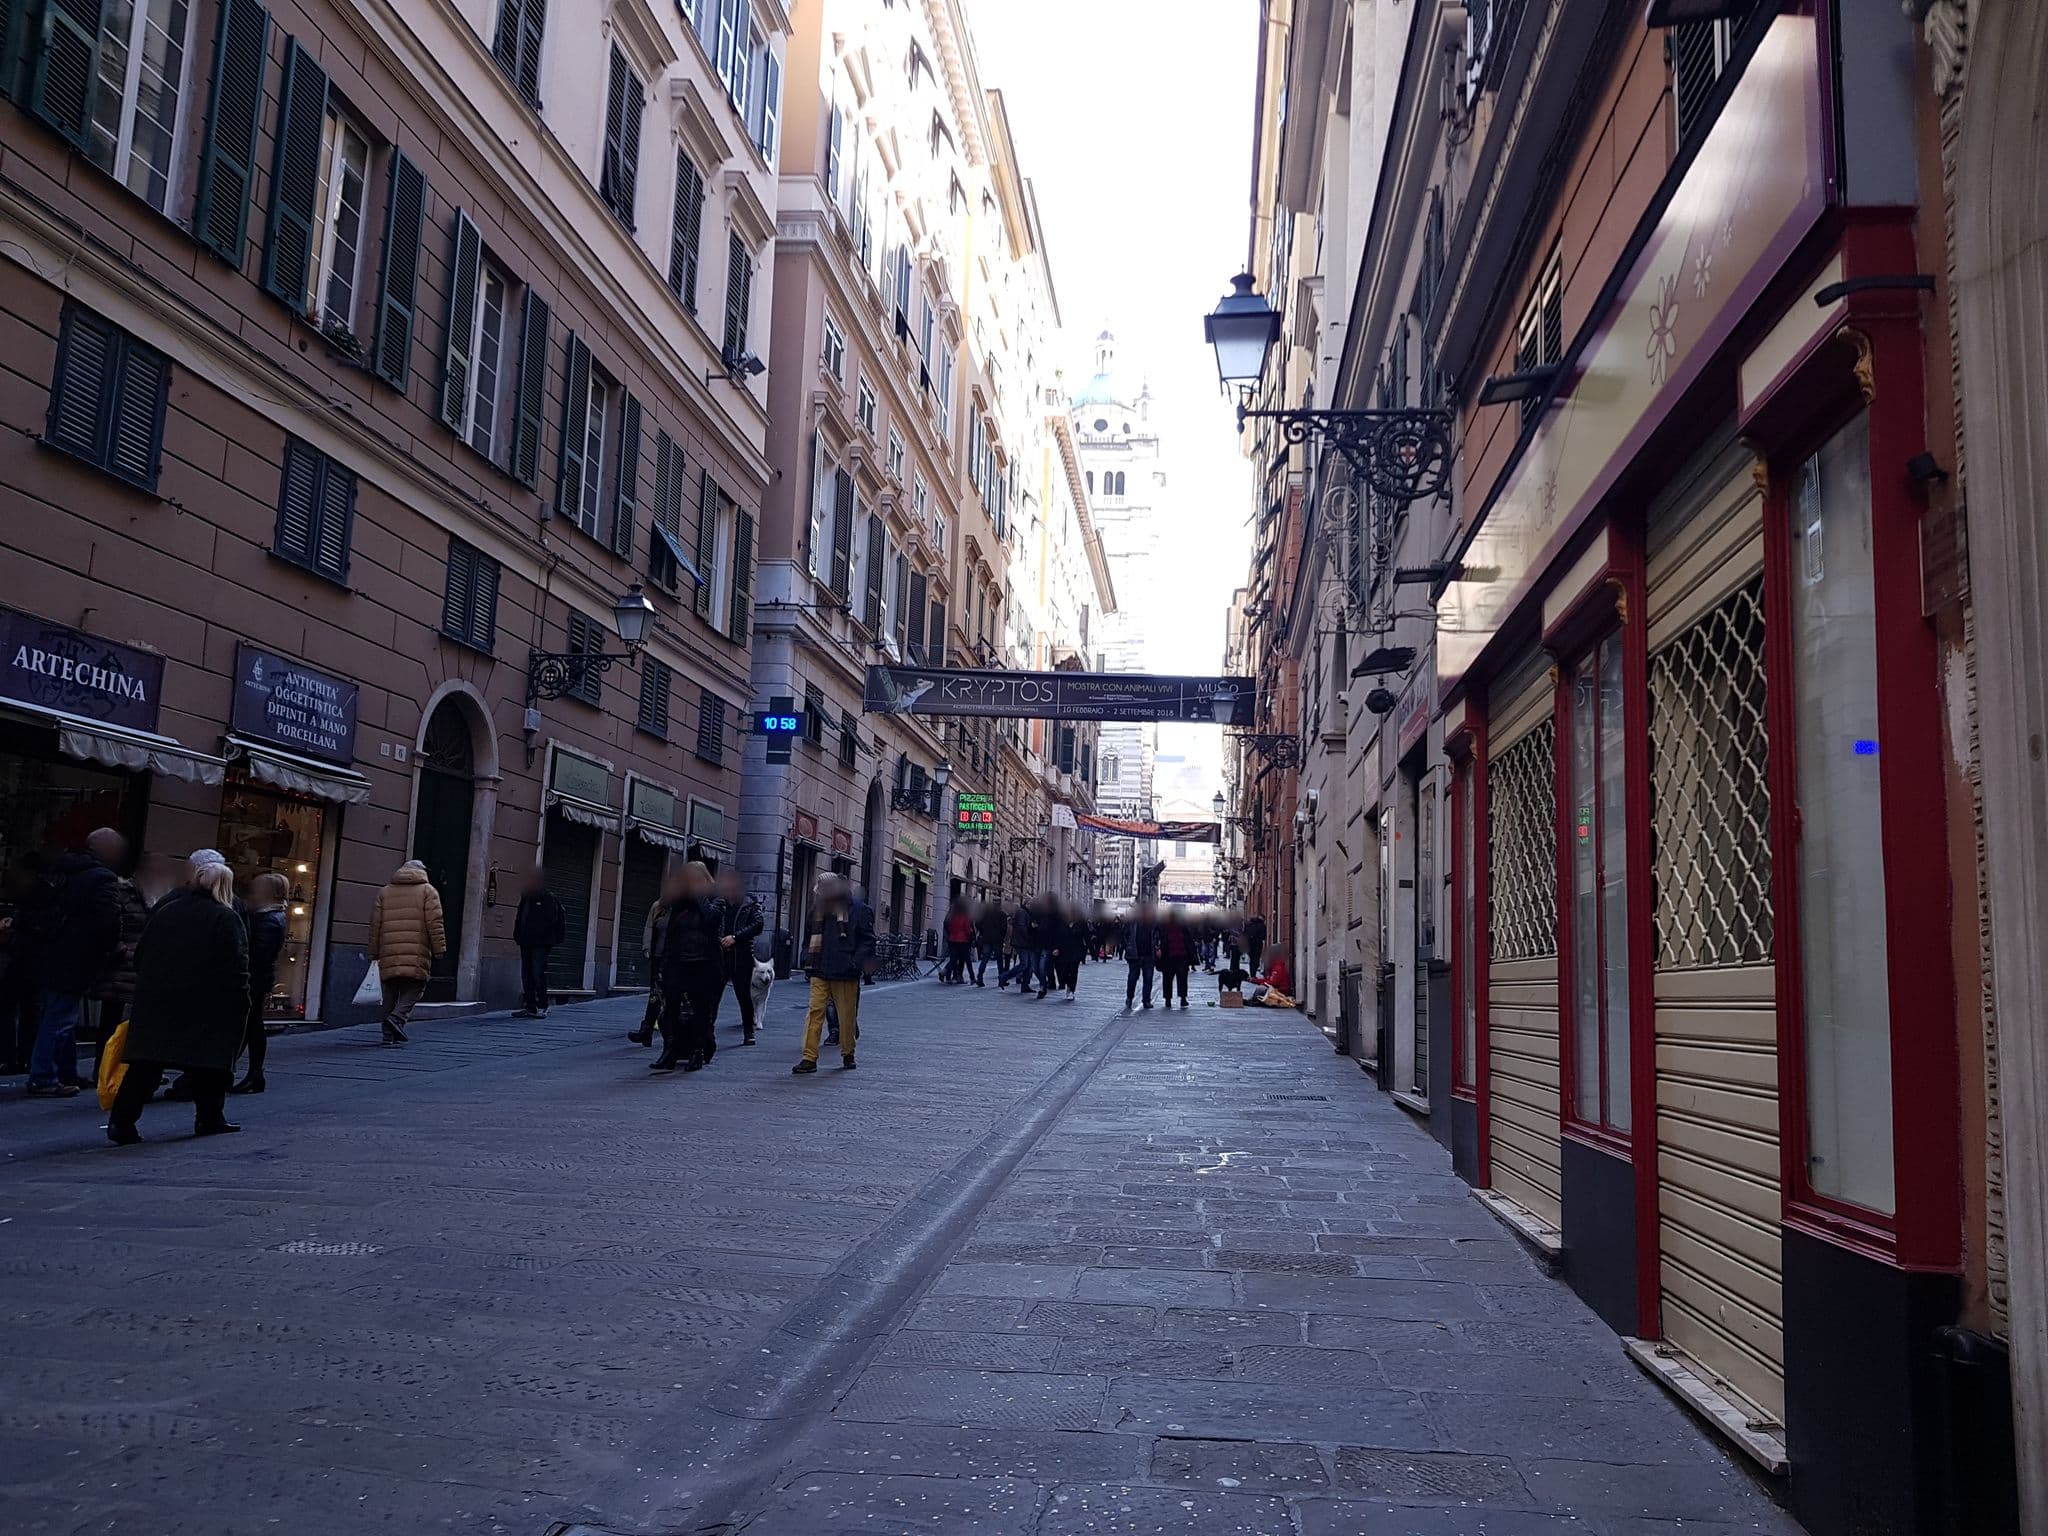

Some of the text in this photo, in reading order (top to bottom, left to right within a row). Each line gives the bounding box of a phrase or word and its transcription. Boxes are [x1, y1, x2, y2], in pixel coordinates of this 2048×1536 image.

[11, 645, 146, 702] ARTECHINA
[285, 672, 339, 700] ANTICHITA'
[1067, 682, 1100, 691] MOSTRA
[1102, 684, 1122, 692] CON
[1124, 684, 1156, 692] ANIMALI
[1197, 683, 1239, 694] MUO
[275, 686, 344, 719] OGGETTISTICA
[1120, 708, 1155, 716] SETTEMBRE
[268, 701, 347, 736] DIPINTI A MANO
[764, 717, 797, 730] 10 58
[277, 722, 337, 750] PORCELLANA
[960, 811, 992, 822] BAR
